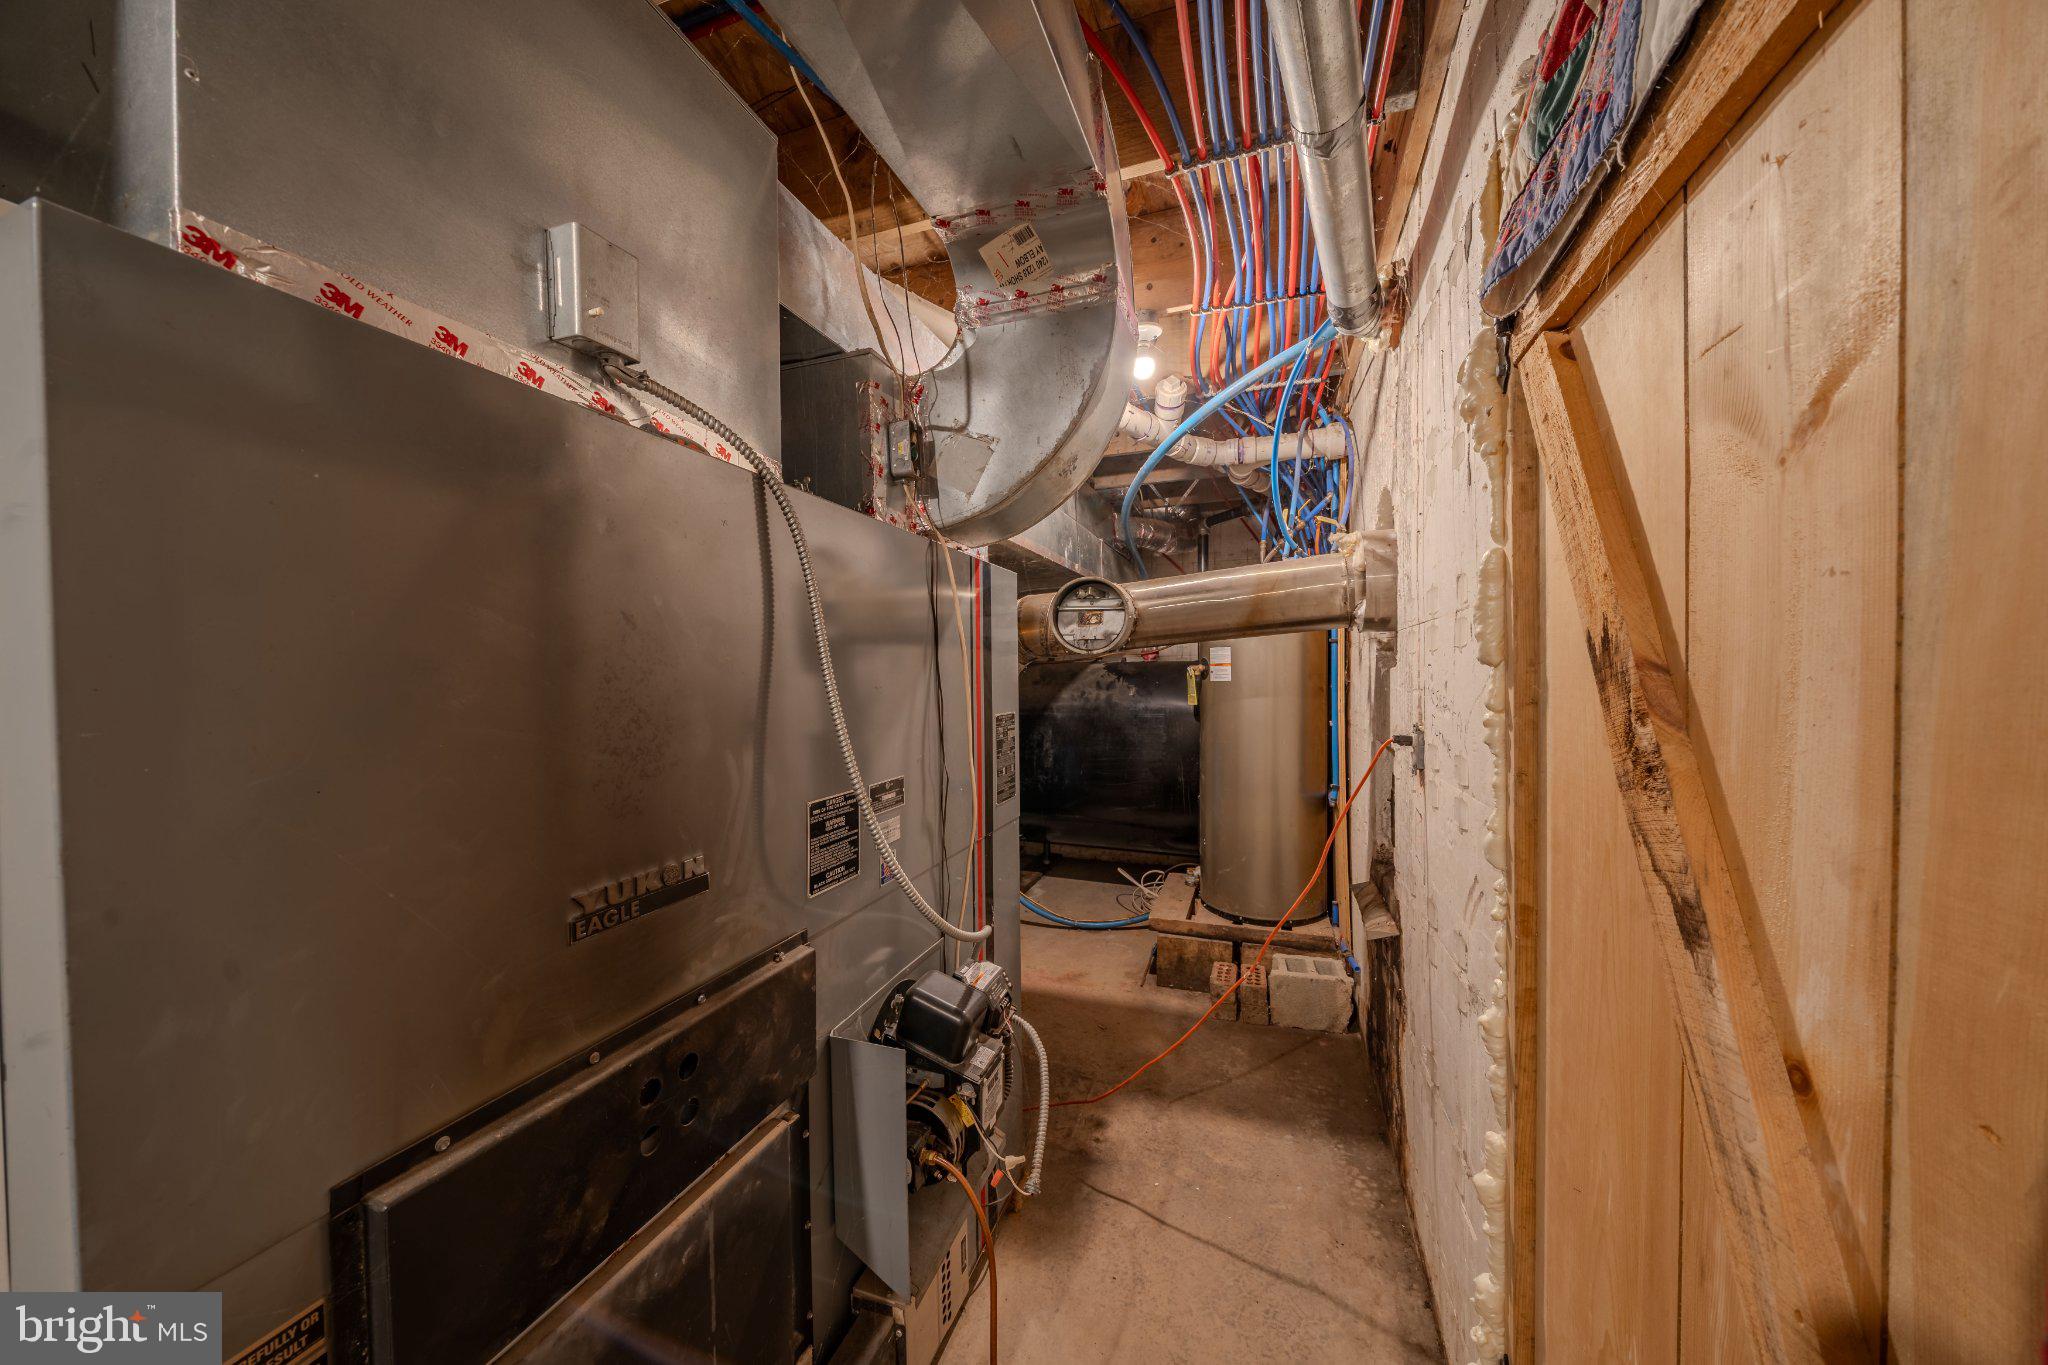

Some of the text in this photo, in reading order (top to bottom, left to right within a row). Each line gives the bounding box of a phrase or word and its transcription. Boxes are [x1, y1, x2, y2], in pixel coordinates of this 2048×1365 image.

[181, 225, 238, 270] 3M
[318, 282, 366, 319] 3M
[367, 289, 413, 327] WEATHER
[434, 325, 470, 359] 3M
[517, 361, 546, 390] 3M
[590, 390, 616, 414] 3M
[715, 443, 732, 463] 3M
[570, 854, 706, 914] YUKON
[575, 900, 641, 940] EAGLE
[301, 1311, 320, 1331] OR
